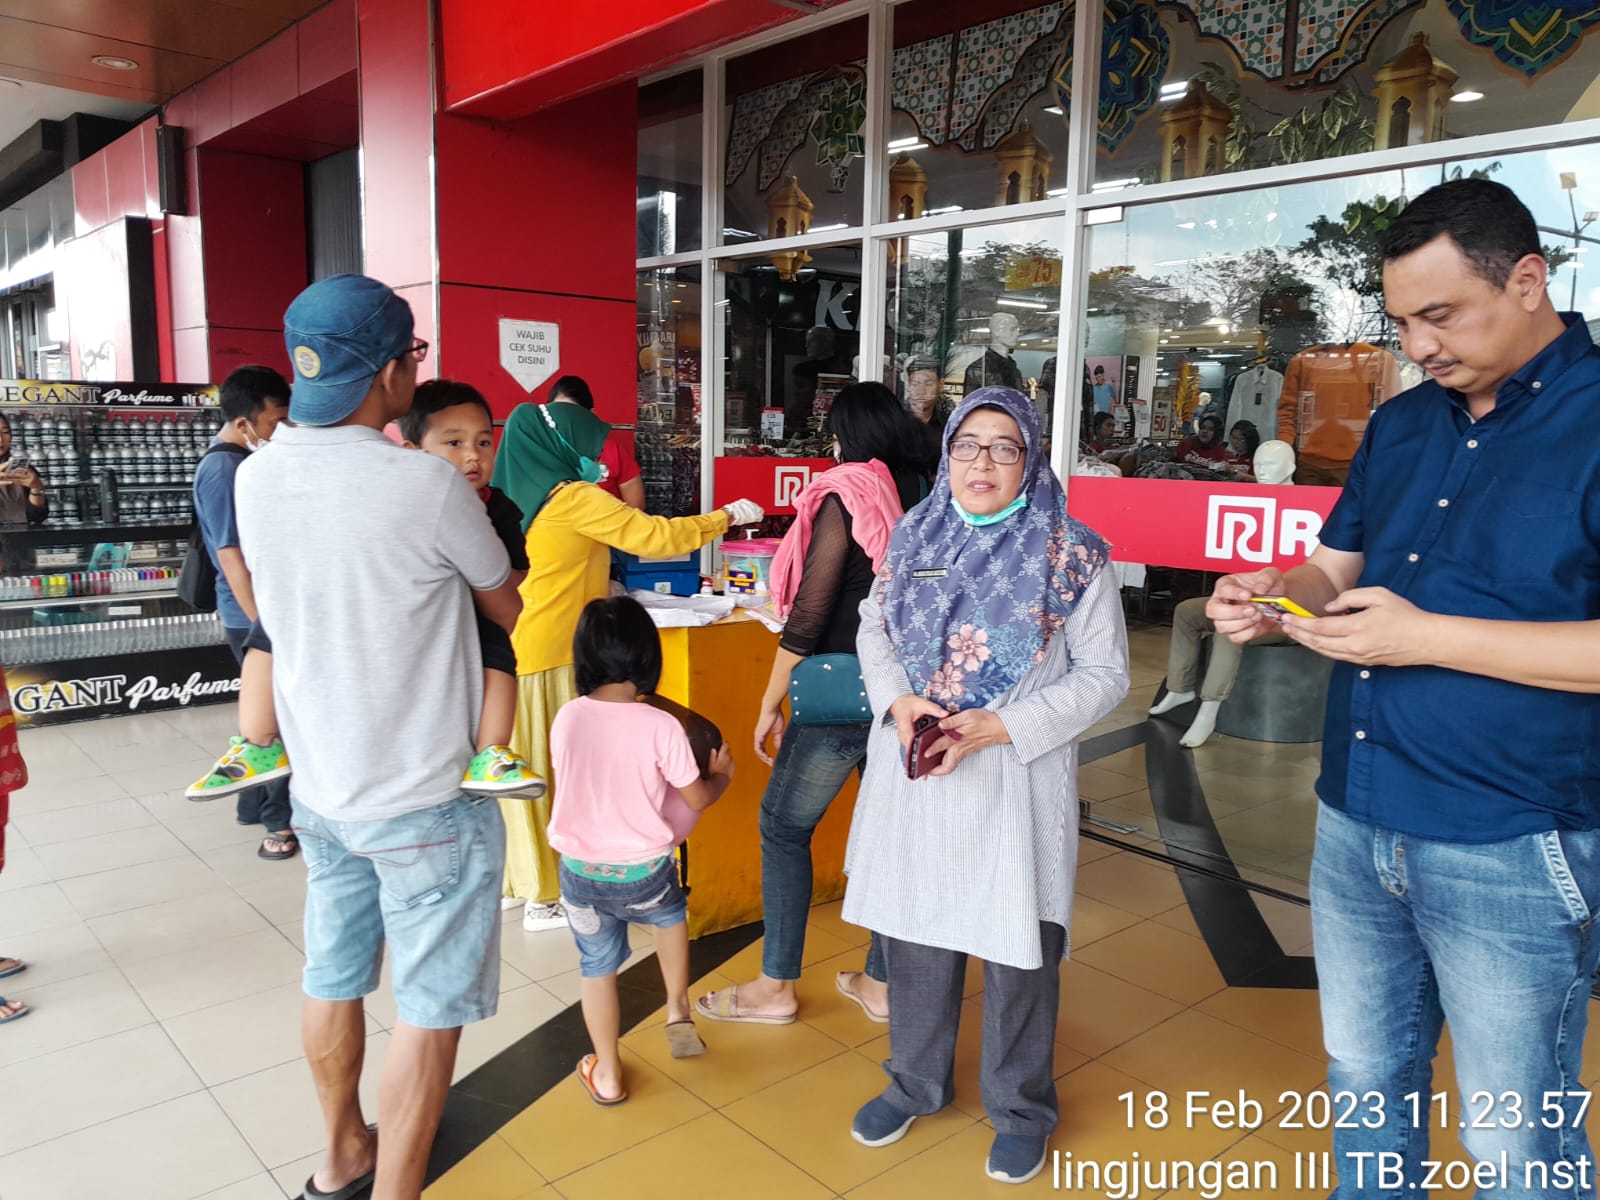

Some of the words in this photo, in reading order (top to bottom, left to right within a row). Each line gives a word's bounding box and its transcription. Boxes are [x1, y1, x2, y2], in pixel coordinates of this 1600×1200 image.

[516, 330, 545, 340] WAJIB
[509, 342, 525, 351] CEK
[527, 344, 552, 353] SUHU
[517, 355, 545, 365] DISINI
[0, 386, 101, 404] EGANT
[101, 388, 175, 404] Parfume
[1154, 415, 1167, 432] 50
[10, 674, 126, 714] GANT
[125, 672, 241, 709] Parfume
